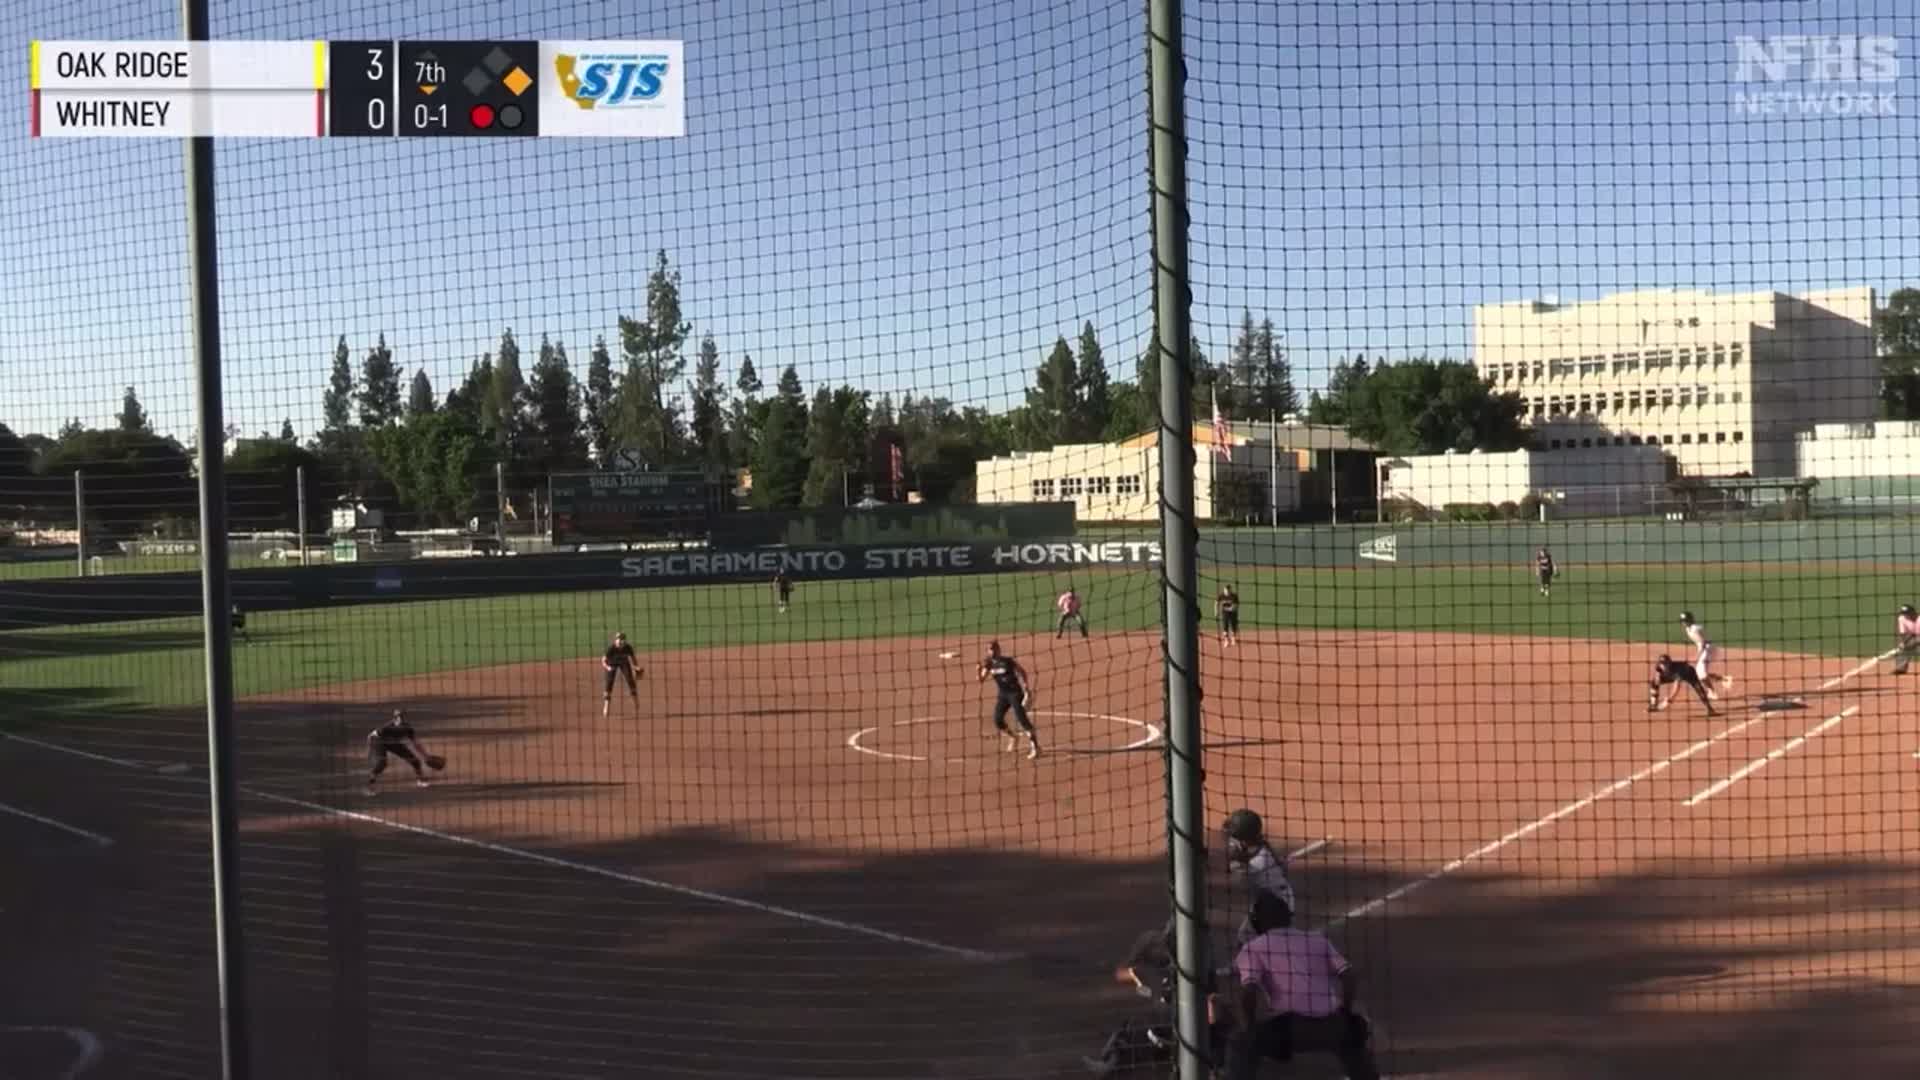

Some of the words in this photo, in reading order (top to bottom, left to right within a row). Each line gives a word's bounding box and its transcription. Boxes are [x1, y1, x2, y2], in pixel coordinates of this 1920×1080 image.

[621, 475, 669, 488] STADIUM
[621, 550, 845, 577] SACRAMENTO
[864, 546, 972, 569] STATE
[991, 541, 1163, 565] HORNETS
